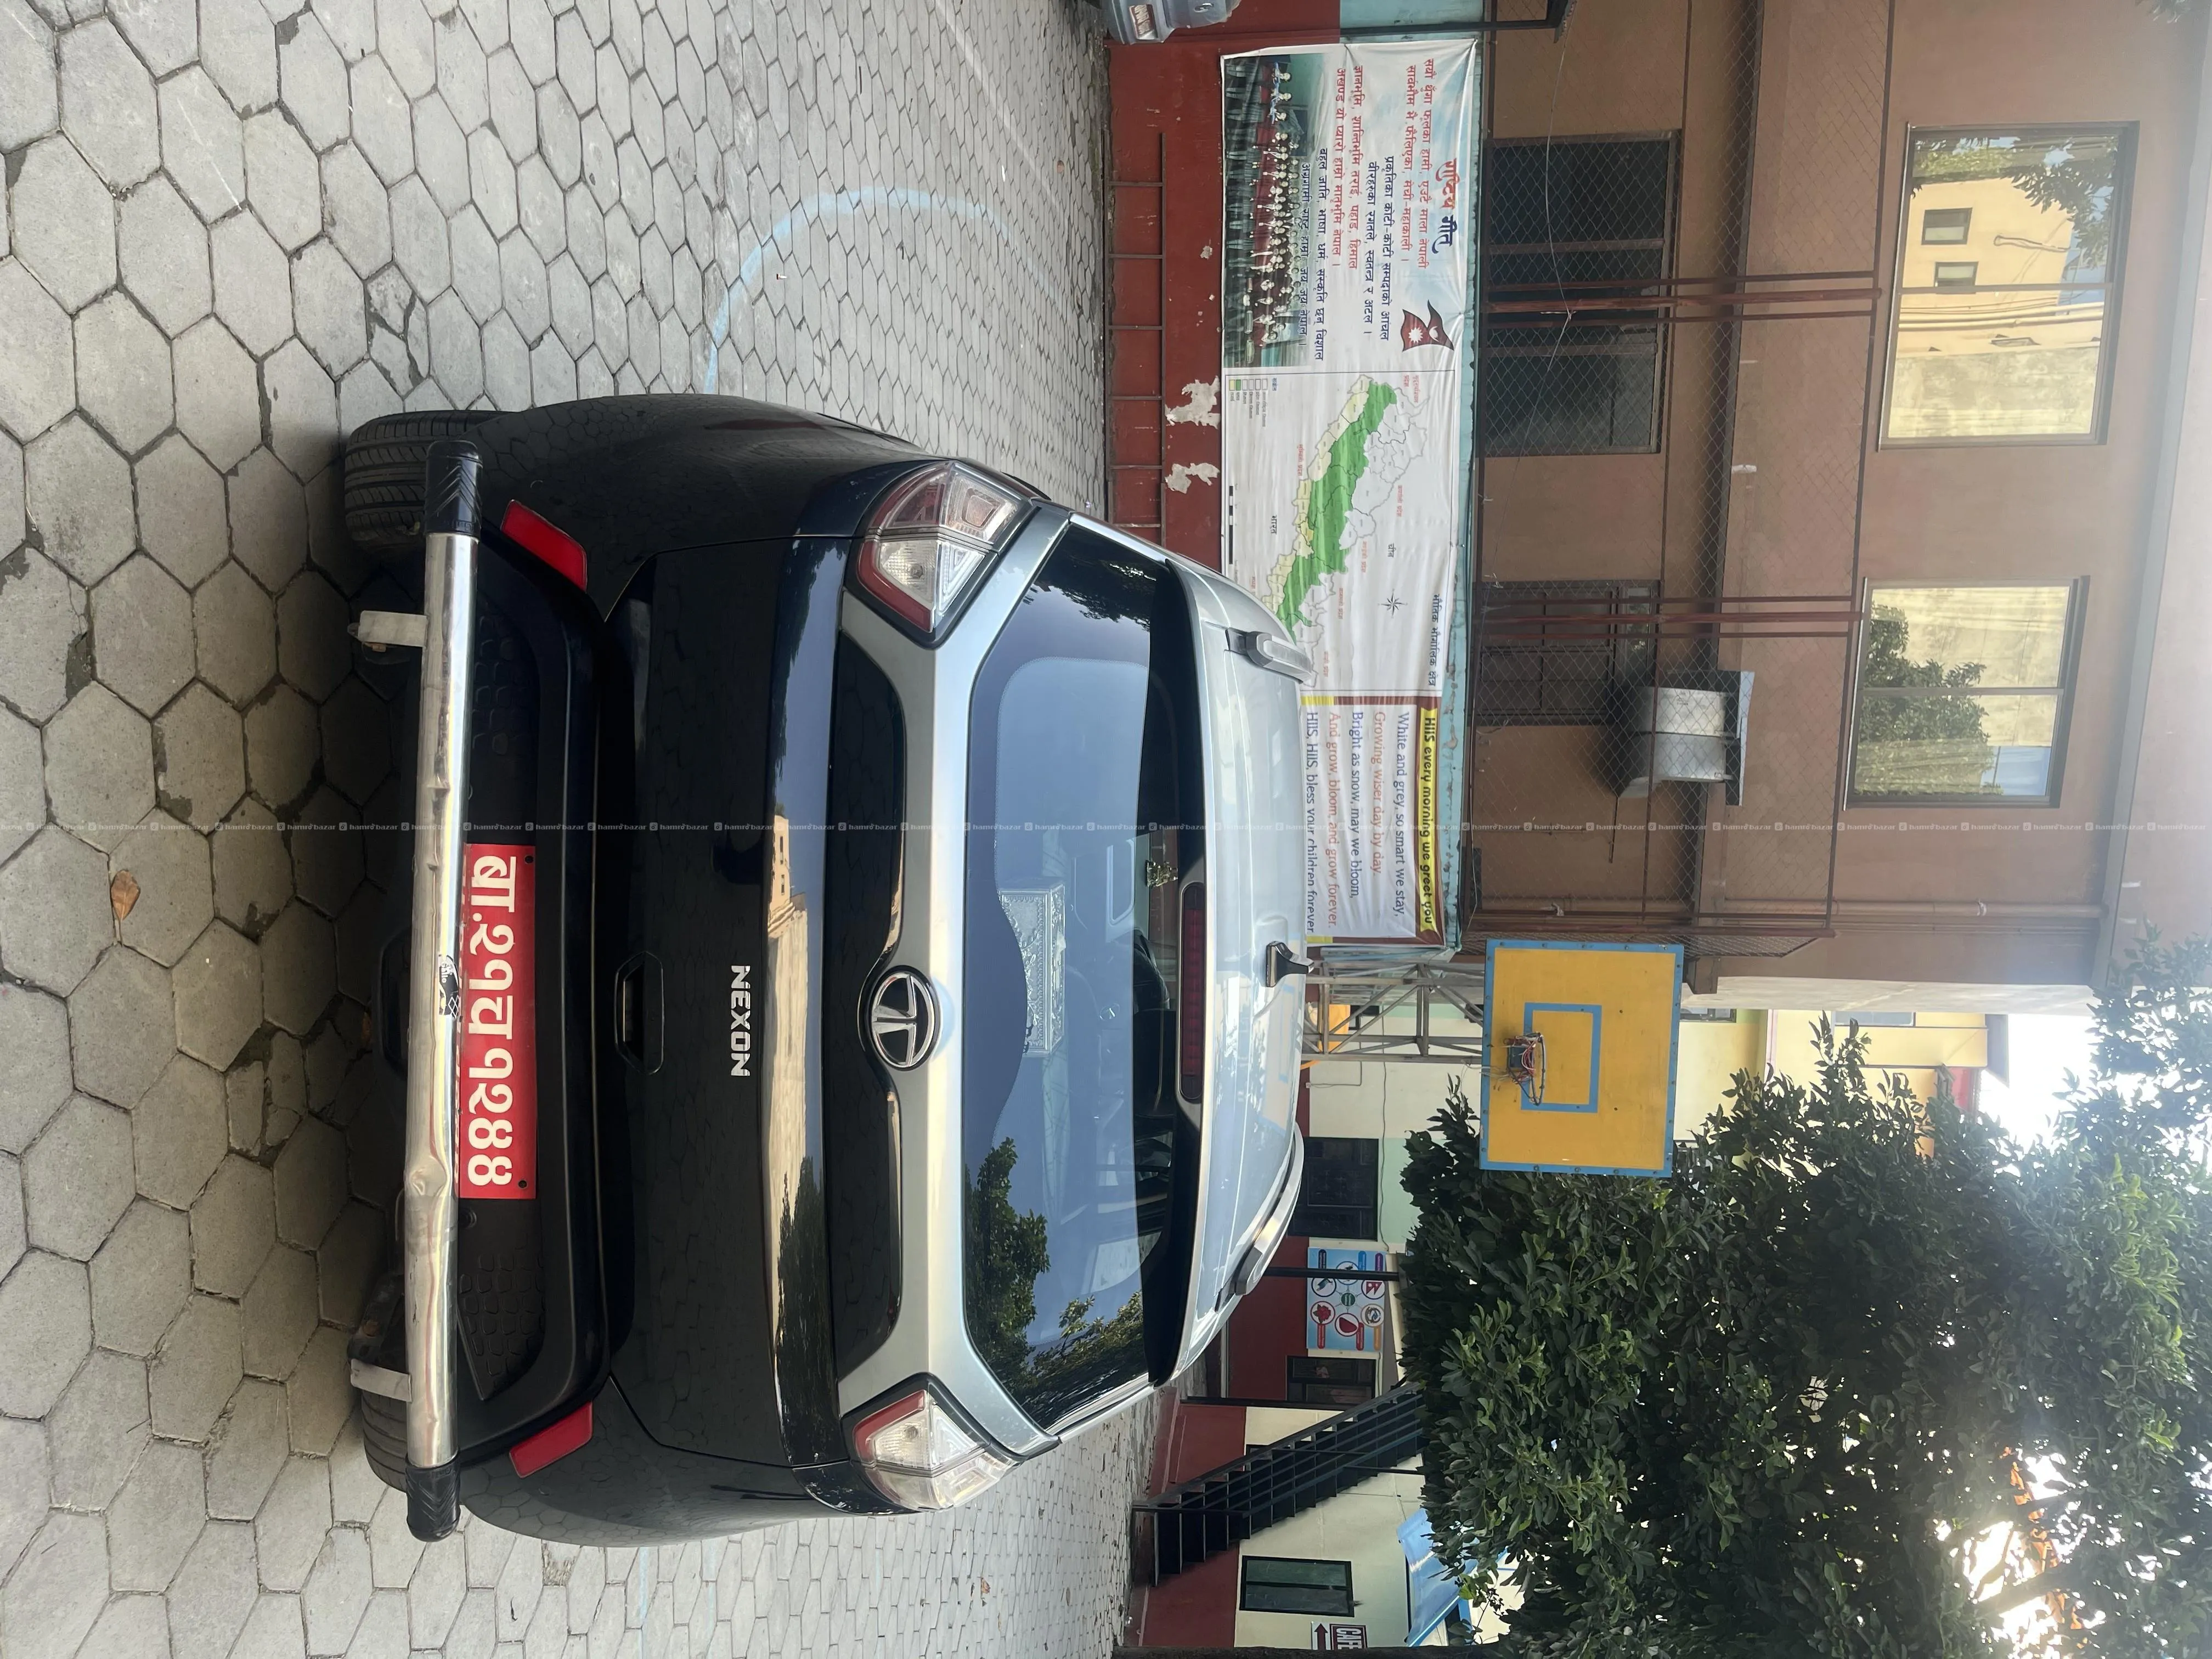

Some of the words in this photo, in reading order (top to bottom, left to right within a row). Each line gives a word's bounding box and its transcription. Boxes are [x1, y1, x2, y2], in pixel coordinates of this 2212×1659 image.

[1335, 68, 1346, 103] अखण्ड
[1406, 65, 1419, 106] सार्वभौम
[1336, 108, 1347, 120] यो
[1420, 109, 1432, 143] फूलका
[1333, 125, 1346, 153] प्यारो
[1316, 148, 1328, 170] बहुल
[1333, 157, 1346, 180] हाम्रो
[1419, 149, 1432, 174] हामी,
[1301, 163, 1312, 202] अग्रगामी
[1381, 156, 1397, 198] प्रकृतिका
[1418, 180, 1432, 204] एउटै
[1297, 208, 1310, 230] राष्ट्र
[1330, 184, 1345, 224] मातृभूमि
[1364, 210, 1377, 244] रगतले,
[1419, 208, 1429, 233] माला
[1432, 215, 1457, 253] गीत
[1332, 229, 1344, 256] नेपाल
[1348, 239, 1361, 269] हिमाल
[1418, 238, 1430, 269] नेपाली
[1299, 267, 1308, 283] जय
[1364, 250, 1374, 281] स्वतन्त्र
[1299, 287, 1308, 304] जय
[1313, 268, 1328, 303] संस्कृति
[1380, 262, 1392, 306] सम्पदाको
[1298, 309, 1310, 336] नेपाल
[1313, 308, 1325, 325] छन्
[1363, 300, 1373, 324] अटल
[1314, 329, 1327, 360] विशाल
[1387, 543, 1396, 557] चीन
[1431, 594, 1443, 623] भौतिक
[1428, 671, 1438, 686] क्षेत्र
[1329, 713, 1341, 737] And
[1349, 712, 1363, 749] Bright
[1371, 712, 1385, 764] Growing
[1397, 712, 1409, 749] White
[1326, 742, 1338, 776] grow,
[1352, 753, 1360, 766] as
[1396, 754, 1407, 776] and
[1421, 747, 1432, 782] every
[1307, 774, 1318, 804] bless
[1328, 780, 1340, 819] bloom,
[1350, 770, 1360, 804] snow,
[1373, 769, 1384, 802] wiser
[1393, 781, 1404, 810] grey,
[1348, 808, 1359, 833] may
[1370, 806, 1384, 828] day
[1396, 814, 1404, 826] so
[1420, 786, 1433, 837] morning
[1329, 822, 1340, 844] and
[1351, 838, 1359, 856] we
[1370, 832, 1384, 848] by
[1395, 831, 1405, 864] smart
[1307, 838, 1317, 886] children
[1325, 849, 1337, 879] grow
[1423, 842, 1430, 860] we
[1350, 860, 1362, 898] bloom,
[1396, 869, 1404, 886] we
[1420, 865, 1432, 896] greet
[1328, 884, 1339, 928] forever.
[1393, 890, 1405, 917] stay,
[1421, 901, 1432, 924] you
[731, 965, 751, 1076] NEXON
[467, 1048, 513, 1187] १२४४
